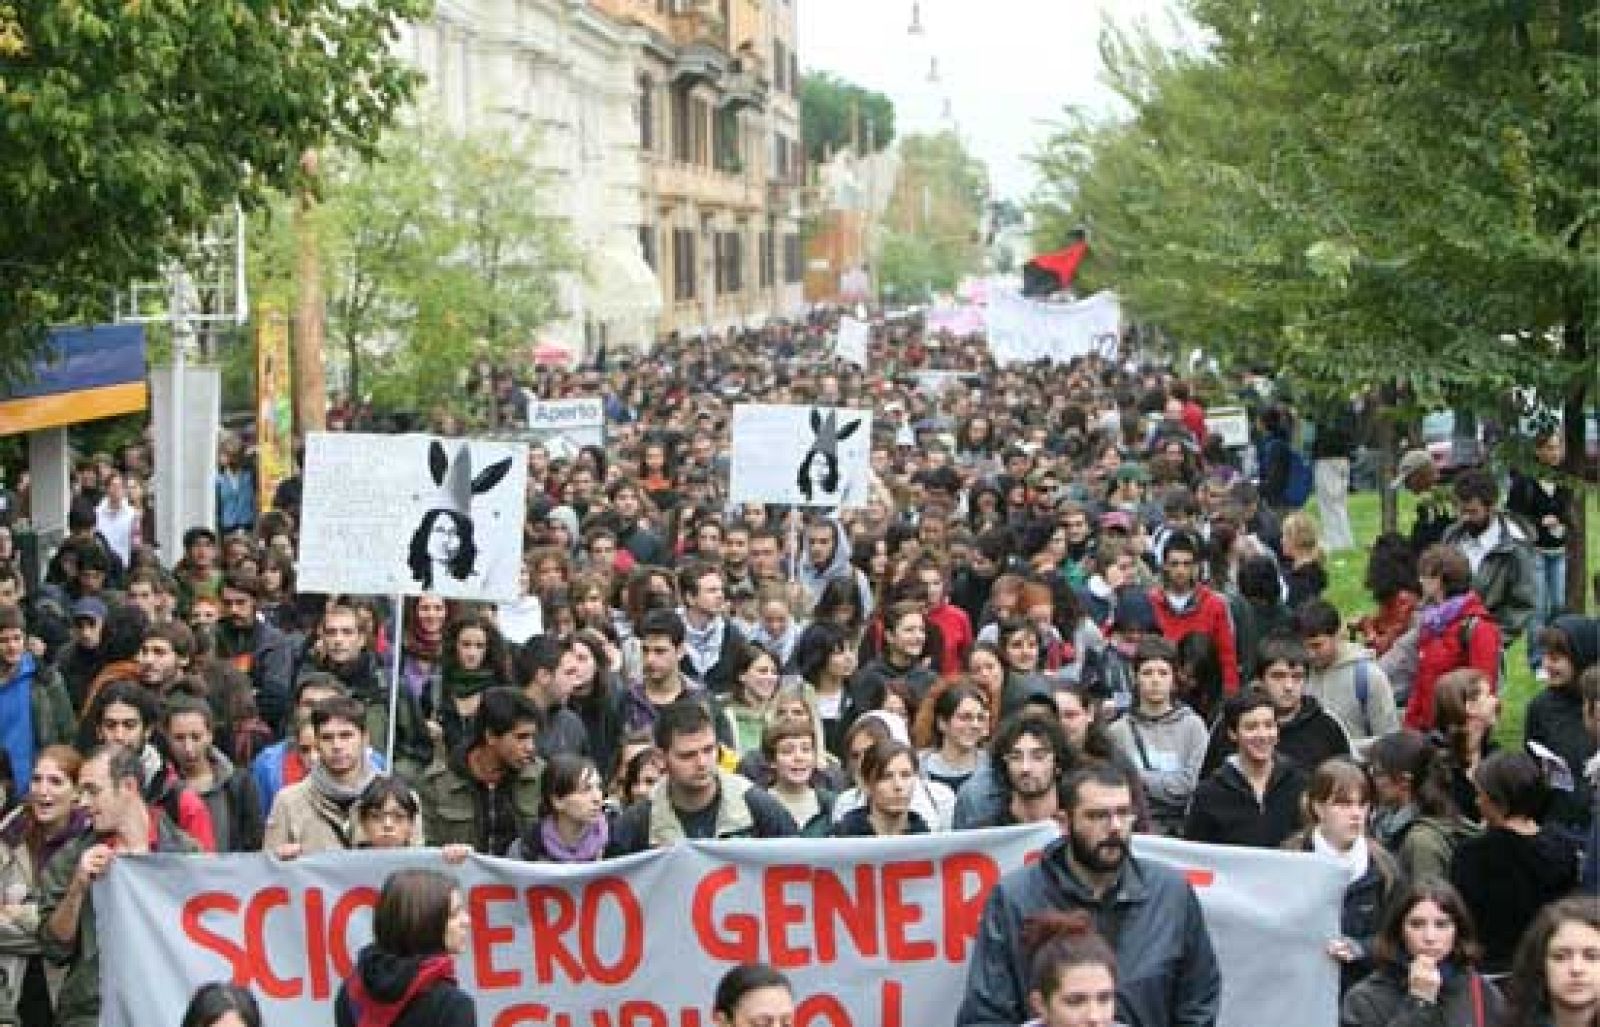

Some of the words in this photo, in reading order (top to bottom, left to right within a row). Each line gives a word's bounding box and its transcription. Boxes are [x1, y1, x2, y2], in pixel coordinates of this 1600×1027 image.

[535, 404, 598, 422] Aperto
[182, 877, 645, 999] SCIOERO
[691, 850, 1214, 967] GENER
